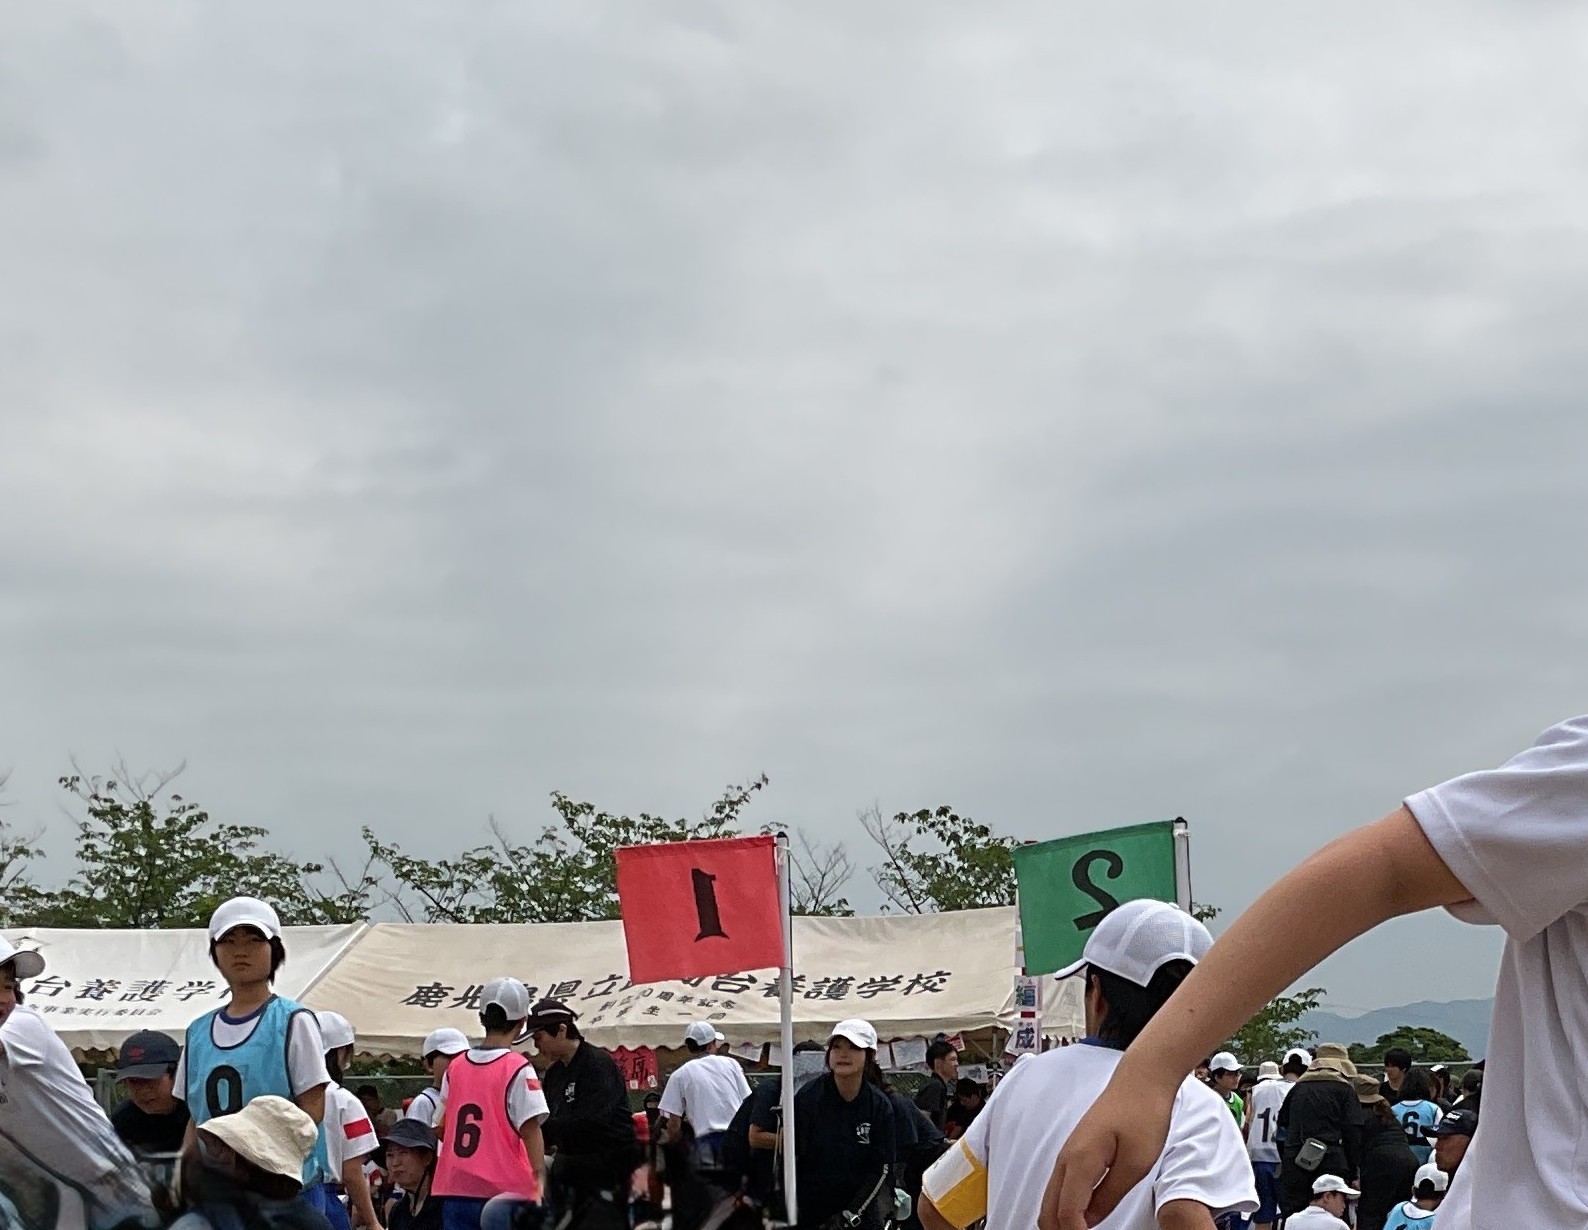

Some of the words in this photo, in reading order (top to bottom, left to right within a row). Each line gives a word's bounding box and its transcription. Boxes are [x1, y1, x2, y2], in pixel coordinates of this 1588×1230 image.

[28, 975, 232, 1002] 台養護学
[453, 1103, 483, 1158] 6
